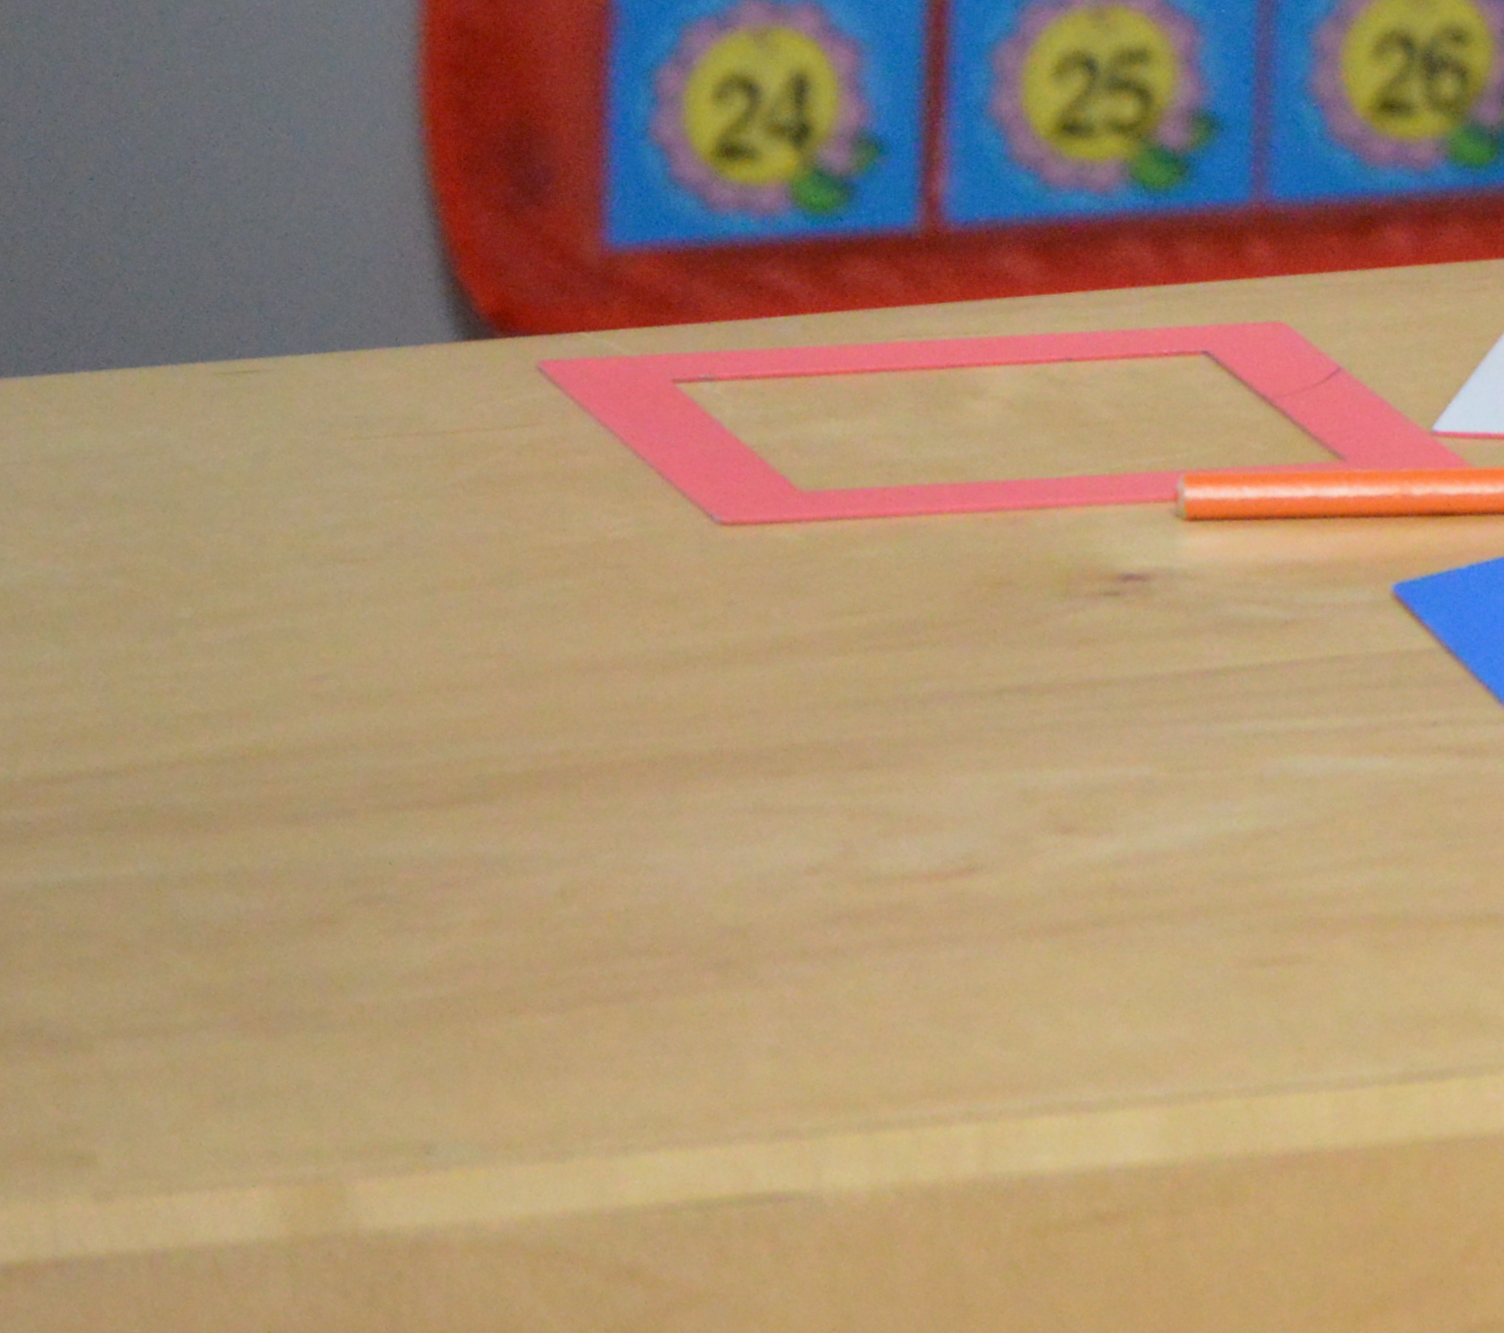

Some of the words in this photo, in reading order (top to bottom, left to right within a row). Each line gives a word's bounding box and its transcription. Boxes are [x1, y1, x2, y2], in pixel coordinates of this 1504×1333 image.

[711, 72, 814, 163] 24
[1052, 49, 1157, 138] 25
[1371, 25, 1470, 120] 26
